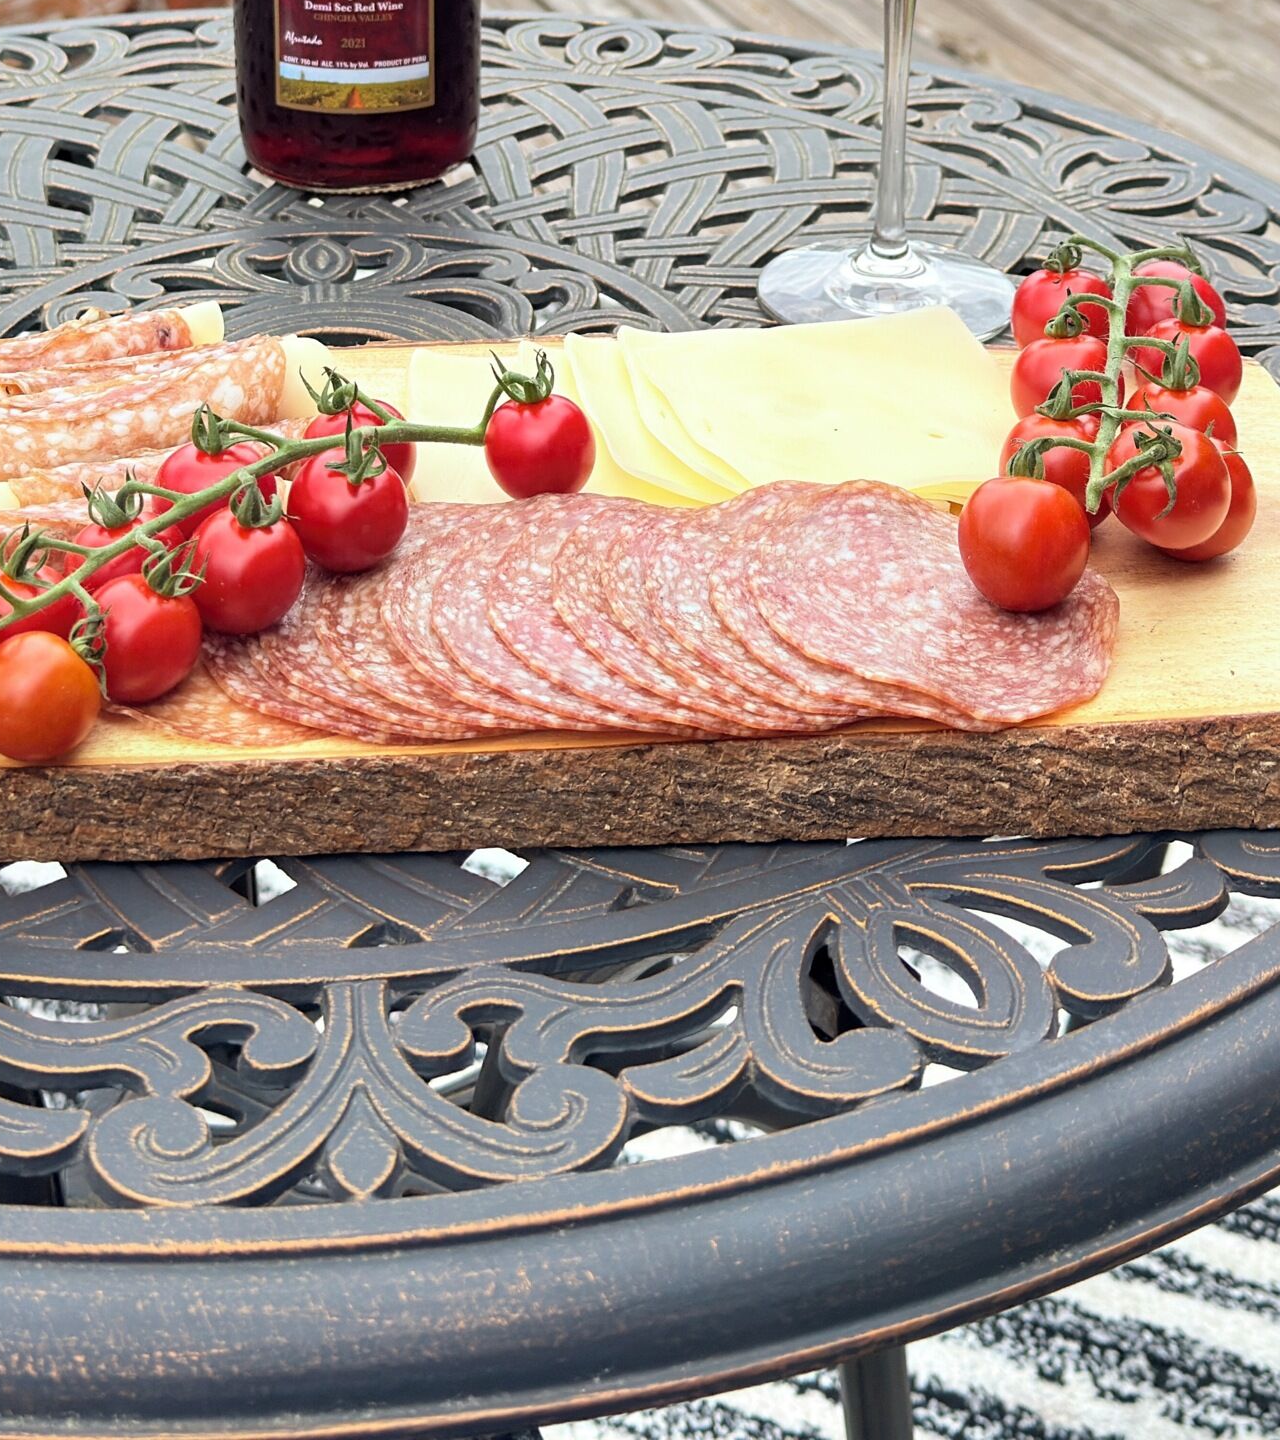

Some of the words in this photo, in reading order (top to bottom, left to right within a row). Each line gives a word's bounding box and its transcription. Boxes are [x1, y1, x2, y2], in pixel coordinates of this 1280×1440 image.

[304, 0, 332, 12] Demi
[334, 2, 352, 12] Sec
[354, 3, 375, 13] Red
[377, 1, 404, 12] Wine
[313, 13, 357, 22] CHINCHA
[359, 13, 394, 22] VALLEY
[285, 30, 323, 45] Afrutado
[341, 38, 366, 48] 2021
[300, 58, 311, 66] 750
[350, 61, 358, 69] by
[374, 59, 402, 68] PRODUCT
[412, 55, 427, 64] PERU
